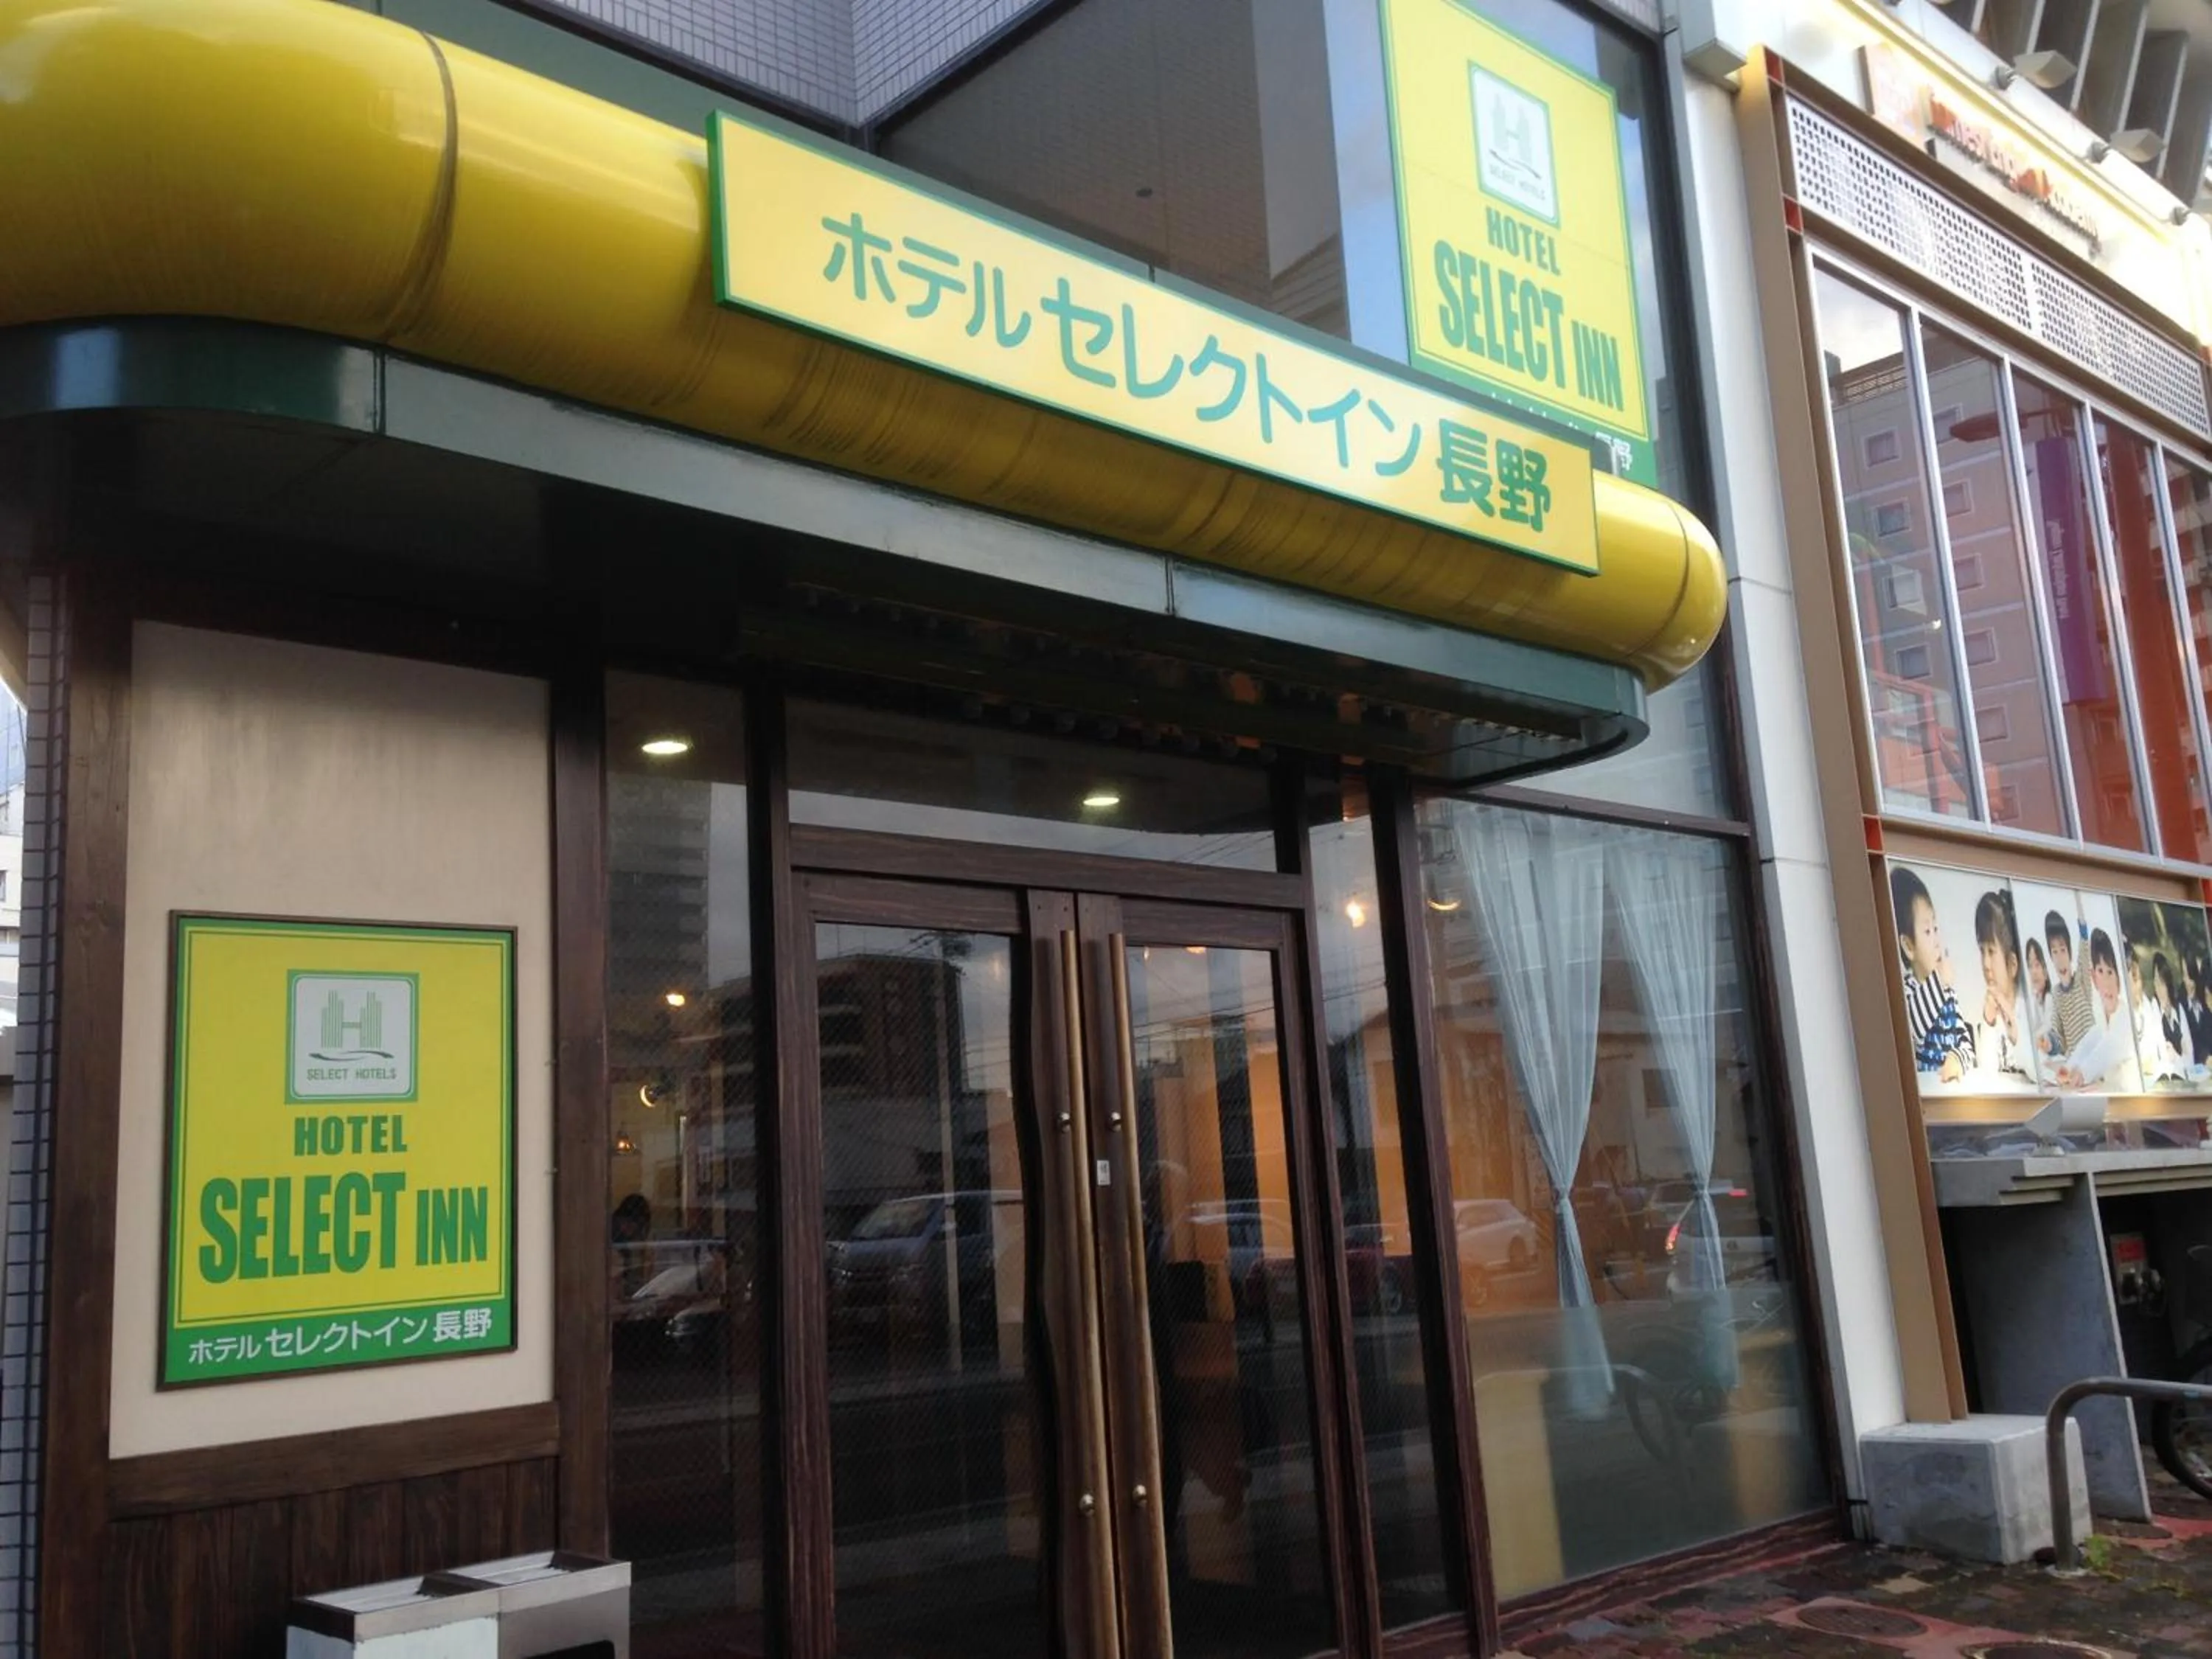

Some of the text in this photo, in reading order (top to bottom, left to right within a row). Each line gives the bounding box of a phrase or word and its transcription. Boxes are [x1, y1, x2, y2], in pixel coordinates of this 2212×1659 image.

[1486, 206, 1560, 275] HOTEL
[1434, 240, 1624, 411] SELECT INN
[307, 1068, 397, 1081] SELECT HOTELS
[294, 1115, 408, 1156] HOTEL
[199, 1172, 488, 1284] SELECT INN
